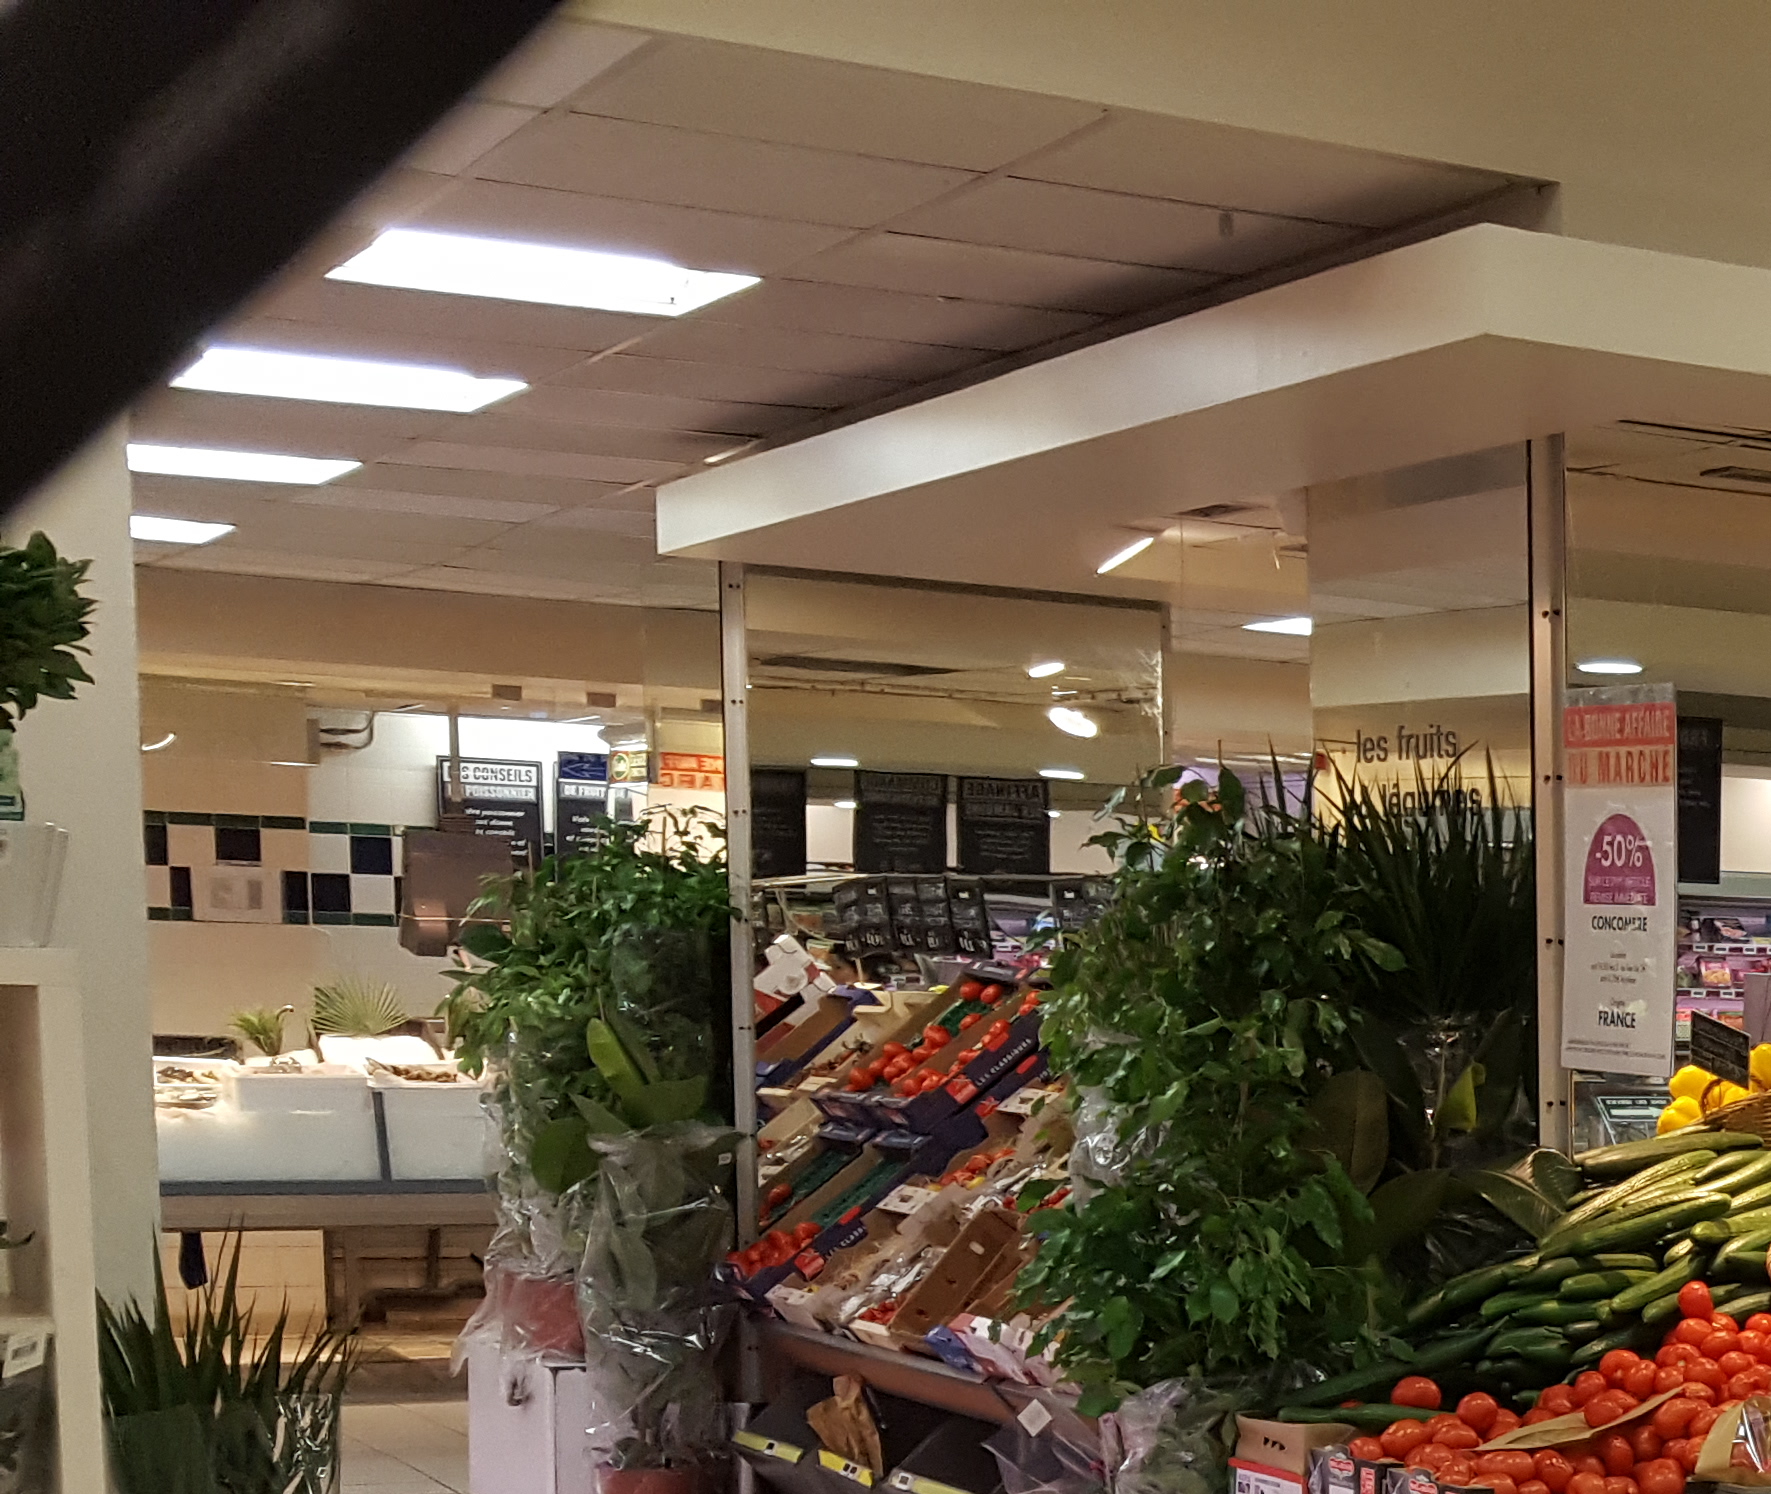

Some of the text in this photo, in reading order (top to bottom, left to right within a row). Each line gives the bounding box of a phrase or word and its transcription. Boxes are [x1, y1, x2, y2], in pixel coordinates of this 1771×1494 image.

[1356, 724, 1457, 764] les fruits
[472, 763, 533, 783] CONSEILS
[1595, 834, 1643, 868] -50%
[1598, 1009, 1636, 1029] FRANCE
